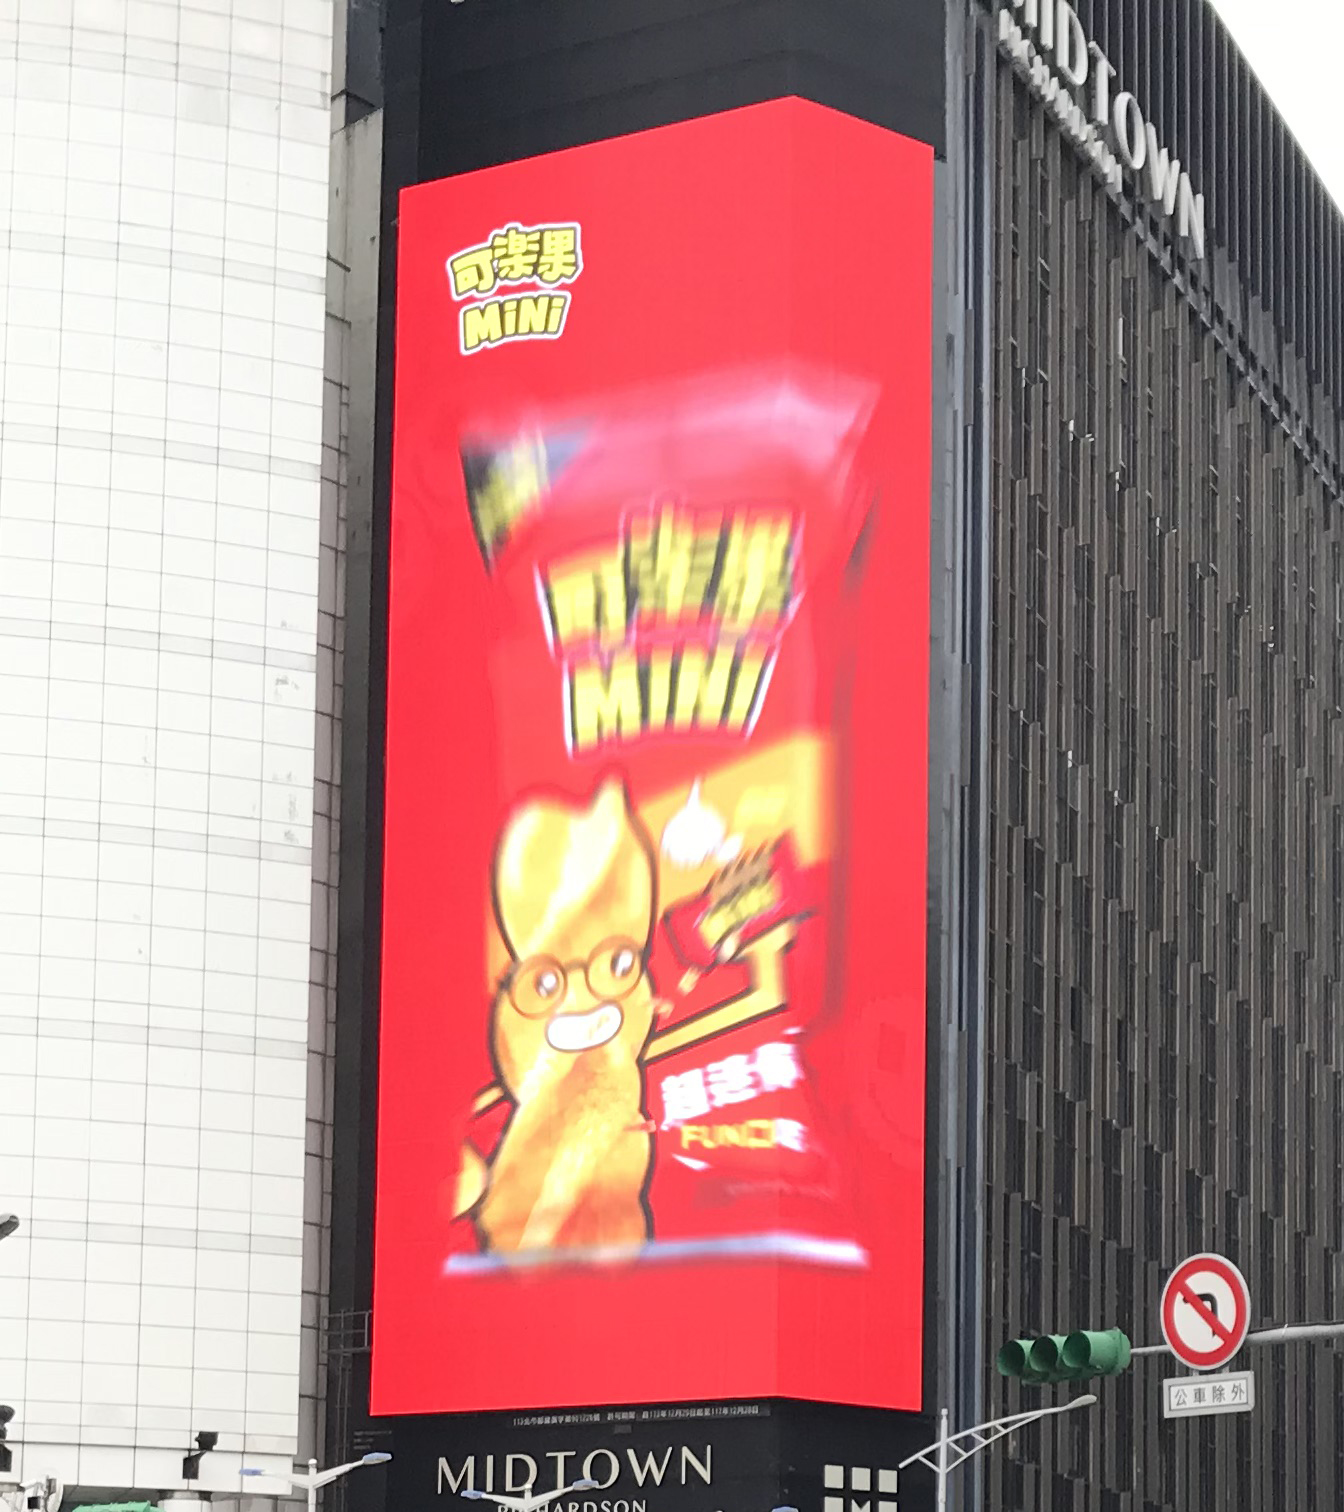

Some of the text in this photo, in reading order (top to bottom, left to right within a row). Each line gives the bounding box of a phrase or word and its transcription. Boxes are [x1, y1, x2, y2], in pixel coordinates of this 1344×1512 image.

[1174, 1382, 1245, 1407] 公車除外
[437, 1444, 712, 1494] MIDTOWN
